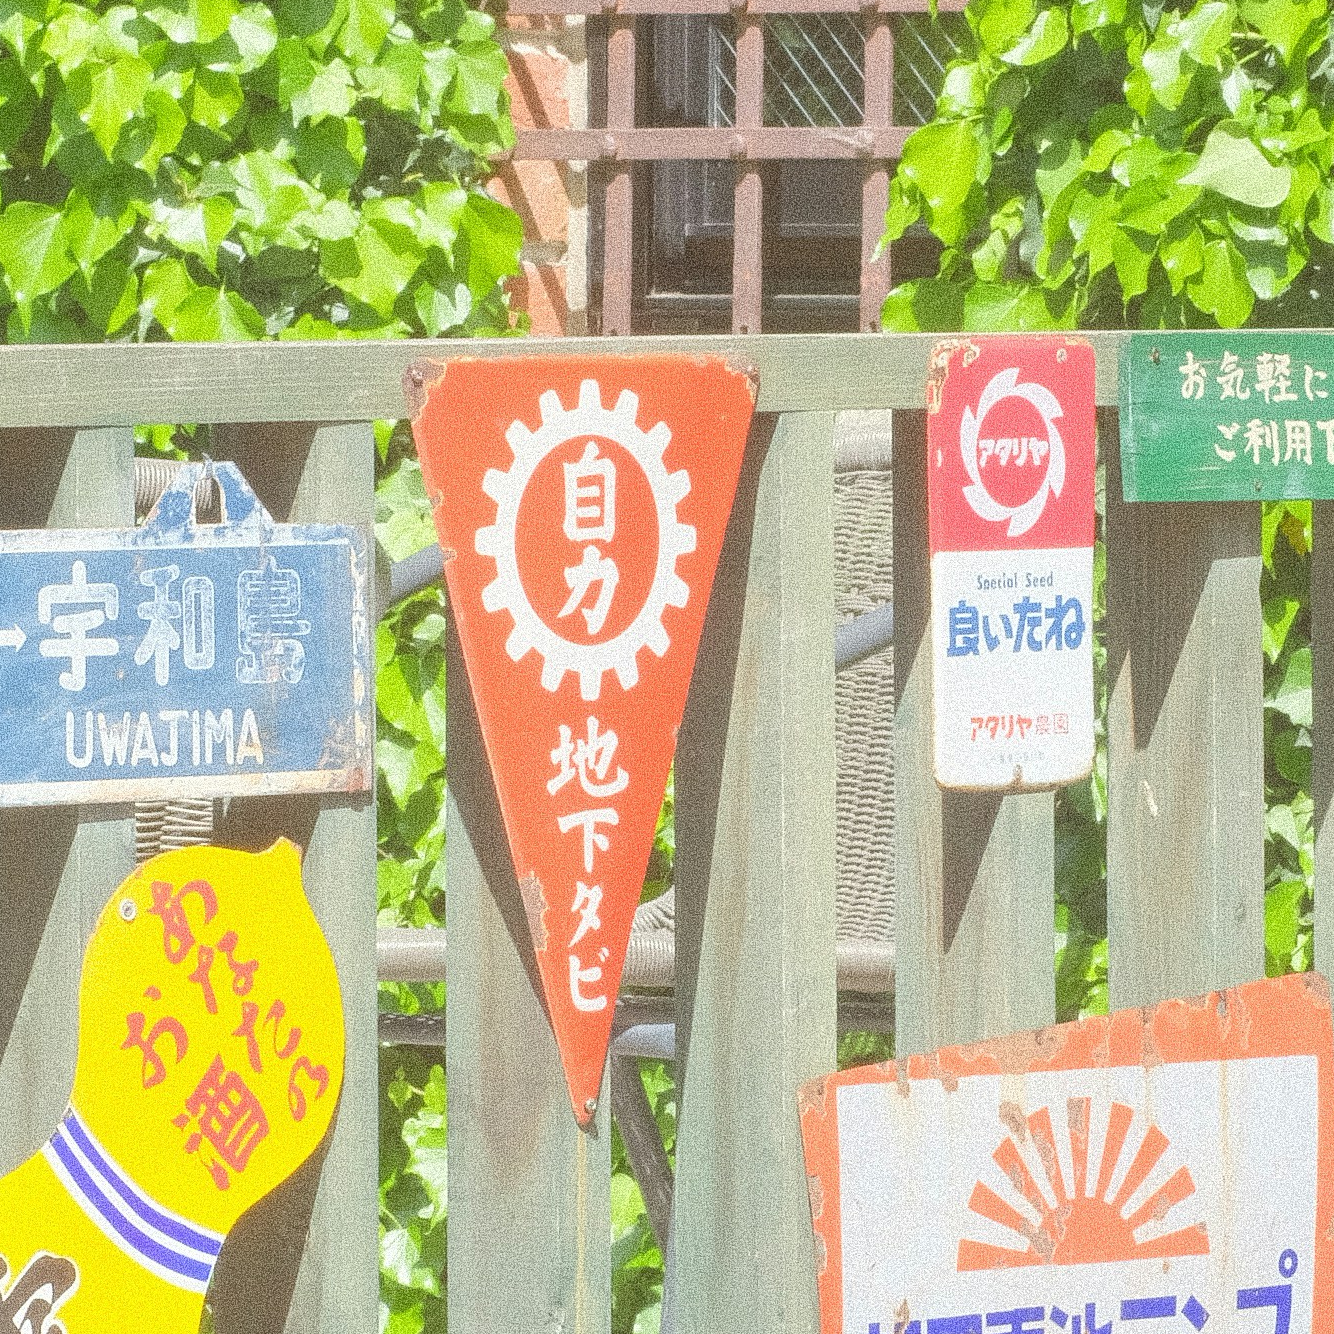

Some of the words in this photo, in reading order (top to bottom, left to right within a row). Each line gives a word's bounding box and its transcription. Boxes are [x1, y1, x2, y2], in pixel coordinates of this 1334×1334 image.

[1179, 349, 1329, 405] お気軽に
[978, 436, 1049, 468] アタリヤ
[558, 440, 619, 636] 自力
[976, 572, 1018, 591] Special
[1025, 570, 1054, 589] Seed
[37, 555, 313, 693] 宇和島
[946, 593, 1087, 658] 良いたね
[64, 707, 266, 769] UWAJIMA
[546, 715, 630, 1014] 地下タビ
[146, 878, 330, 1123] あなたの
[121, 986, 271, 1192] お酒
